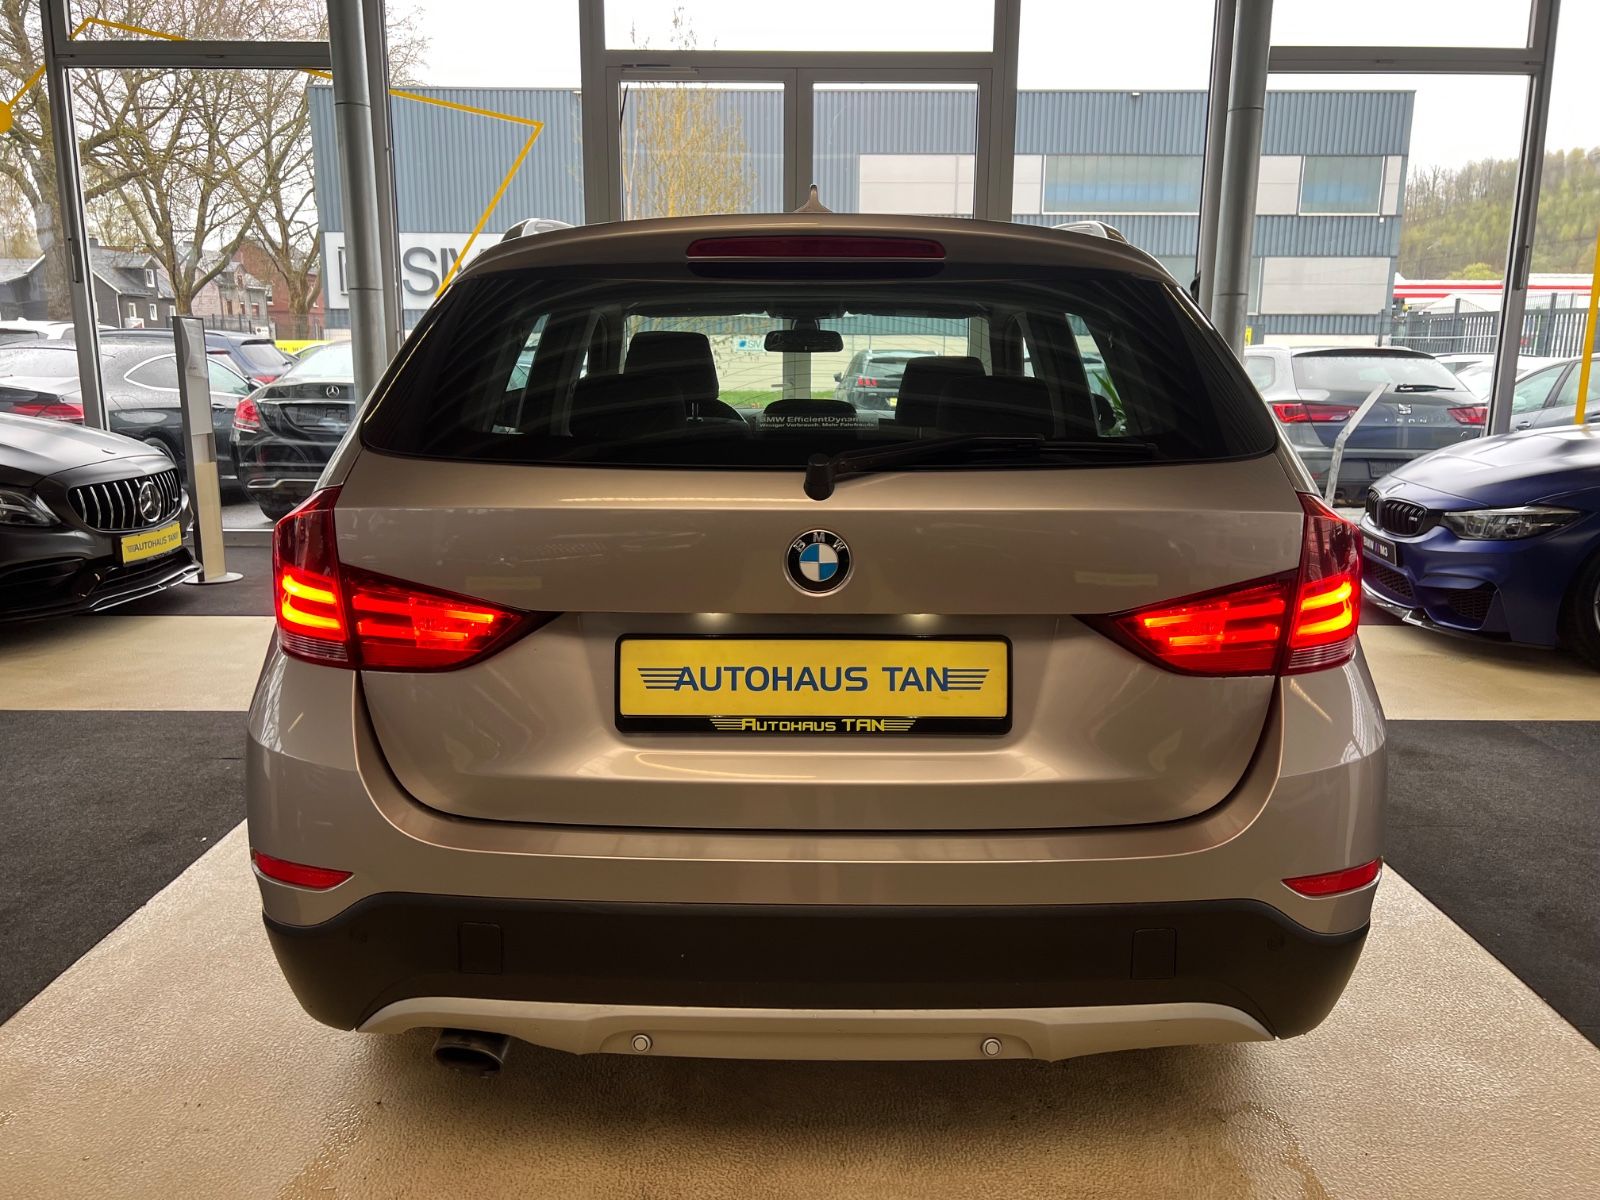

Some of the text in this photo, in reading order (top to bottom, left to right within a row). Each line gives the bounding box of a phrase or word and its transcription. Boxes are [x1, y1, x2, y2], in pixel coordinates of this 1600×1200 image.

[134, 536, 167, 551] AUTOHAUS
[792, 531, 846, 553] BMW
[674, 666, 949, 692] AUTOHAUS TAN
[845, 718, 885, 732] TAN
